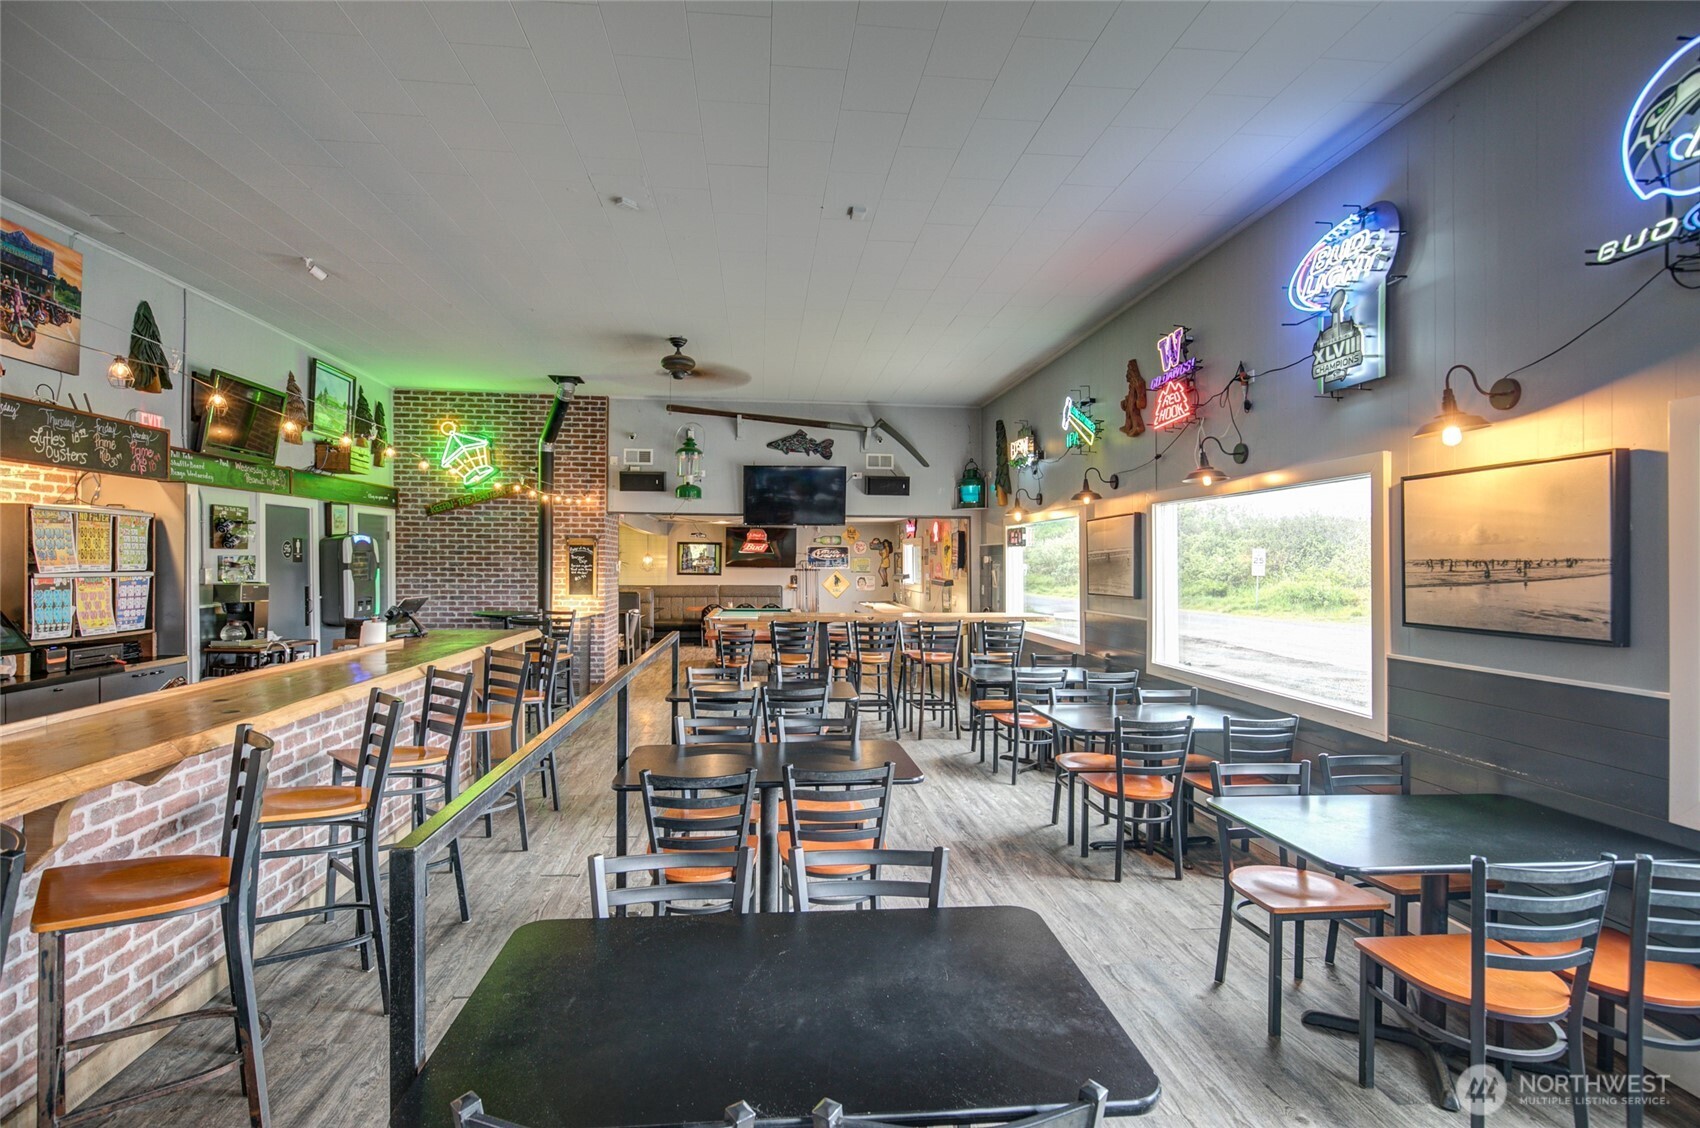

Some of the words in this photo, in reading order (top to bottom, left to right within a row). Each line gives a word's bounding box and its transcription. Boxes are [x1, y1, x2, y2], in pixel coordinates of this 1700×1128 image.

[1597, 217, 1678, 262] BUD
[1310, 229, 1377, 275] BUD
[1301, 247, 1382, 299] LIGHT
[1157, 327, 1183, 372] W
[1313, 335, 1361, 366] XLVIII
[1314, 354, 1360, 375] CHAMPIONS
[1162, 391, 1181, 408] RED
[39, 408, 80, 432] Thursday
[140, 412, 163, 428] EXIT
[1159, 402, 1186, 422] HOOK
[1066, 431, 1080, 448] IPA
[46, 445, 88, 465] Oysters
[79, 512, 88, 521] NO
[745, 543, 766, 551] Bud
